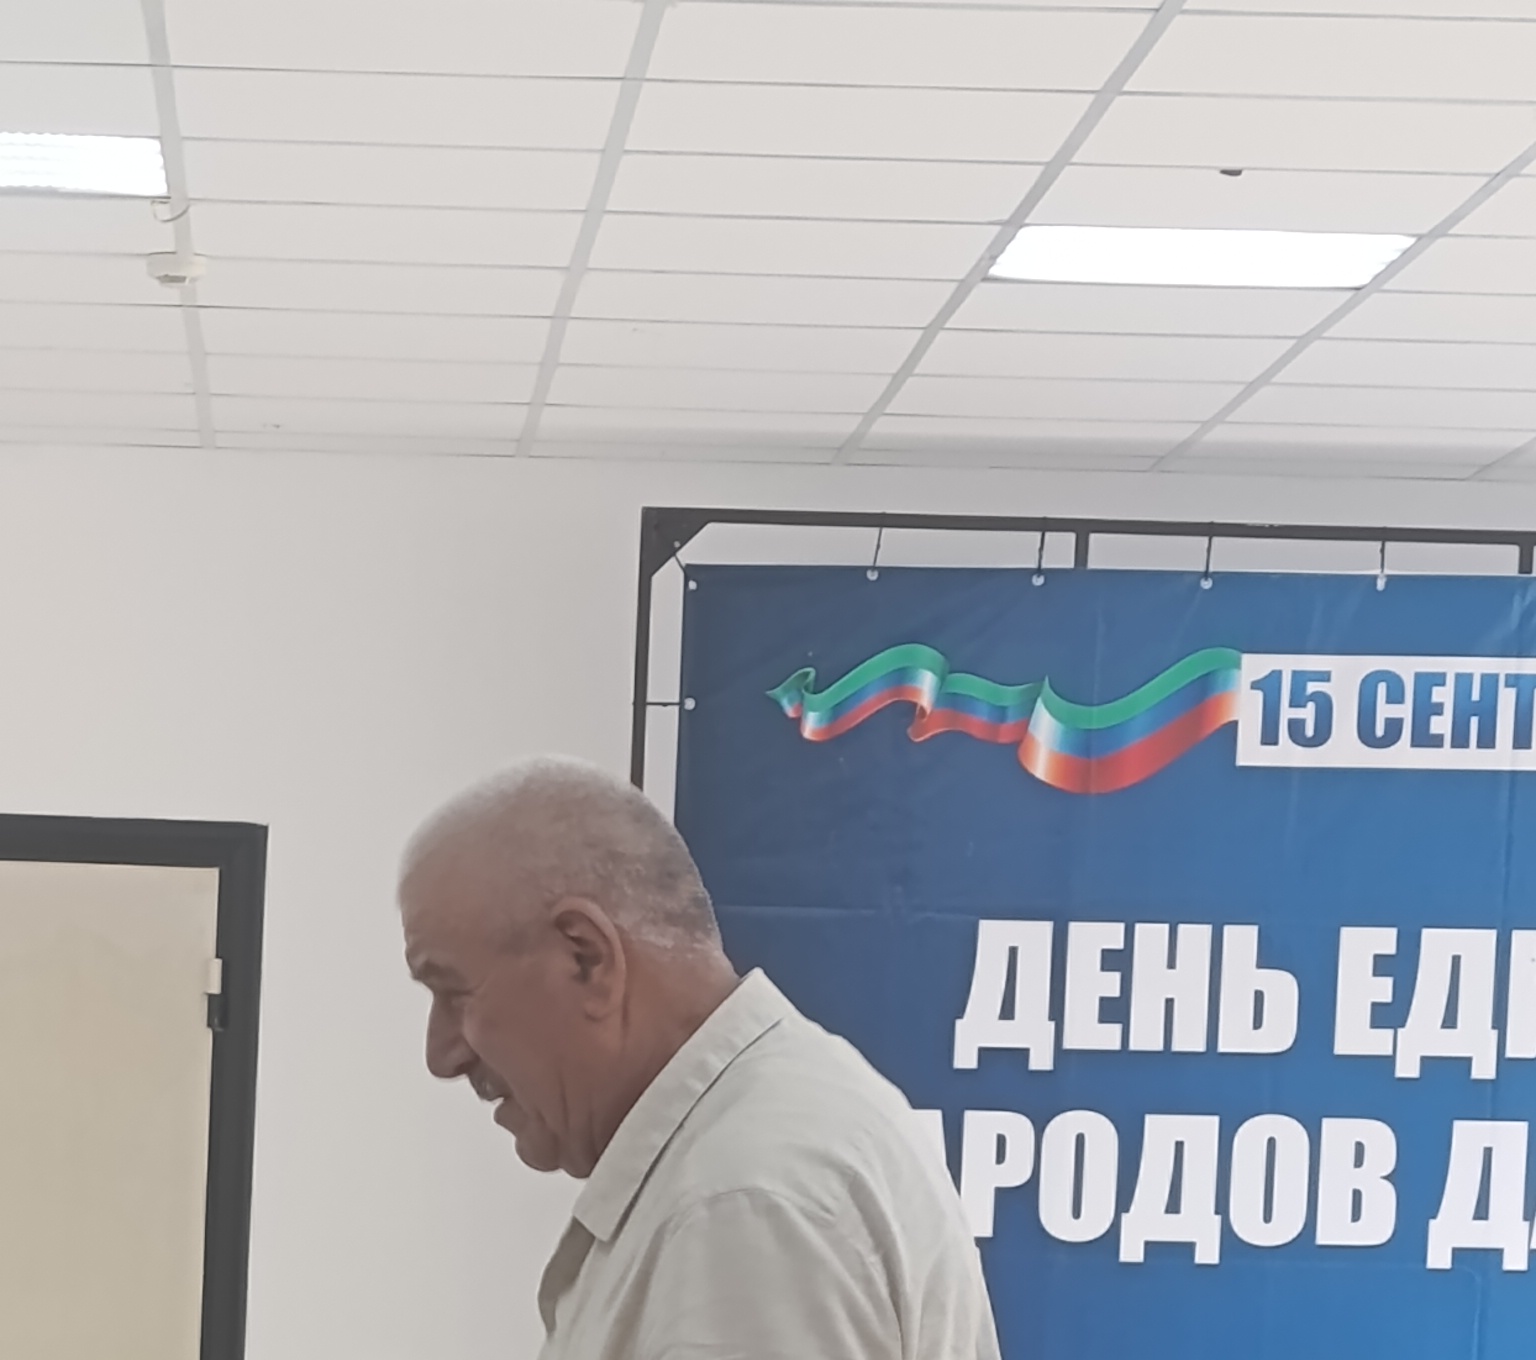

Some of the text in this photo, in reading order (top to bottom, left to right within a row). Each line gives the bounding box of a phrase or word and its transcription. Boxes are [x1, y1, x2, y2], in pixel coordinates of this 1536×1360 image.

[1250, 669, 1536, 750] 15 СЕНТ
[953, 919, 1300, 1071] ДЕНЬ
[1426, 1119, 1536, 1272] Д
